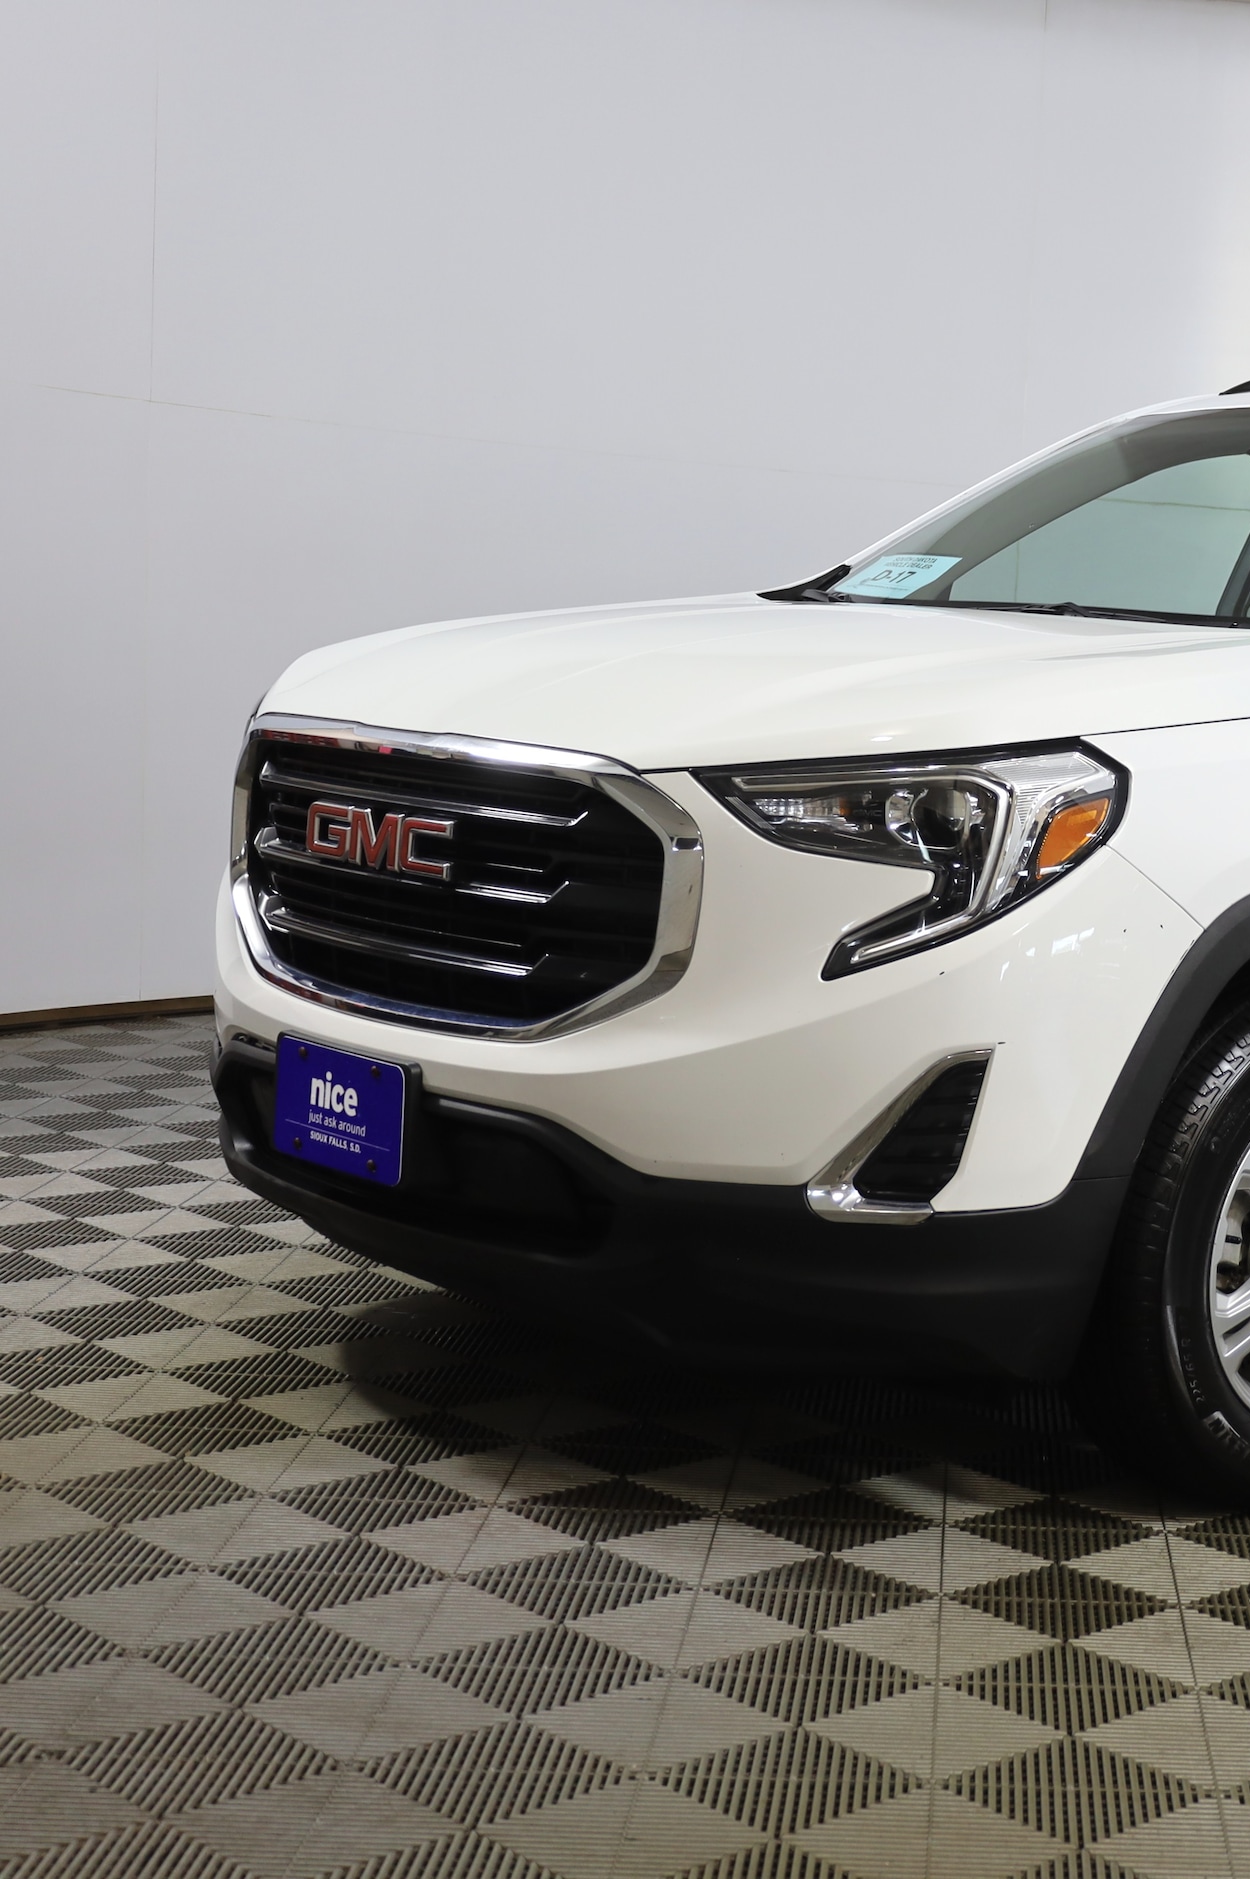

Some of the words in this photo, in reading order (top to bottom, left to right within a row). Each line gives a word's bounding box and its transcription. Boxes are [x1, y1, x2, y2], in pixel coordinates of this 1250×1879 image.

[871, 569, 917, 584] D-17
[909, 562, 934, 570] DEALER
[306, 801, 455, 881] GMC
[310, 1071, 358, 1117] nice
[308, 1109, 323, 1124] just
[323, 1116, 337, 1129] ask
[338, 1120, 366, 1137] around
[310, 1130, 328, 1144] SIOUX
